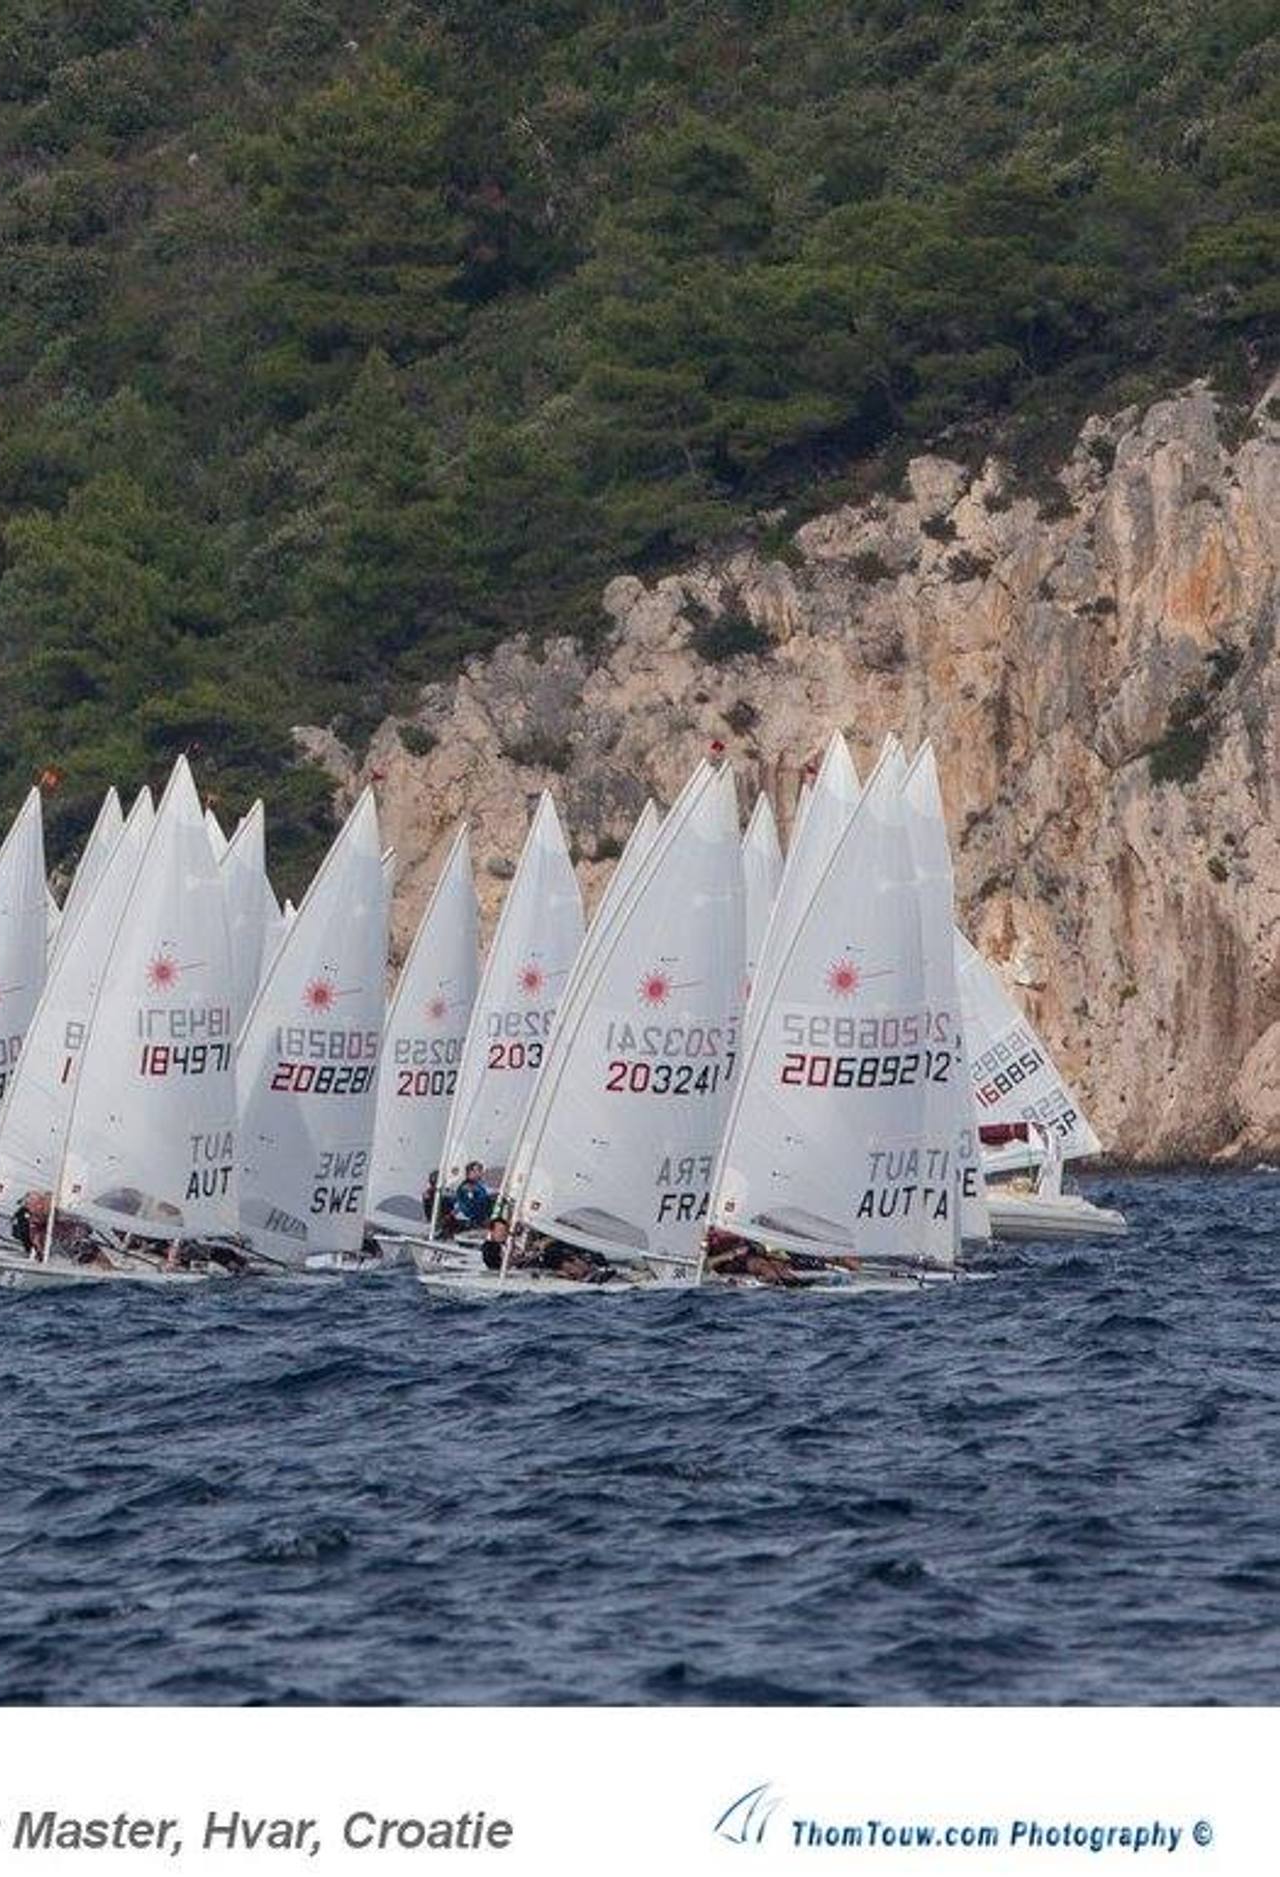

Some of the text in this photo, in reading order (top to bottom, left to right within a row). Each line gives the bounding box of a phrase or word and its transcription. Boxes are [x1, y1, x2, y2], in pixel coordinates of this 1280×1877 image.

[140, 1043, 232, 1076] 184971
[270, 1061, 376, 1095] 208281
[606, 1061, 720, 1095] 203241
[975, 1047, 1045, 1109] 168851
[185, 1165, 233, 1201] AUT
[309, 1184, 364, 1214] SWE
[657, 1191, 710, 1223] FRA
